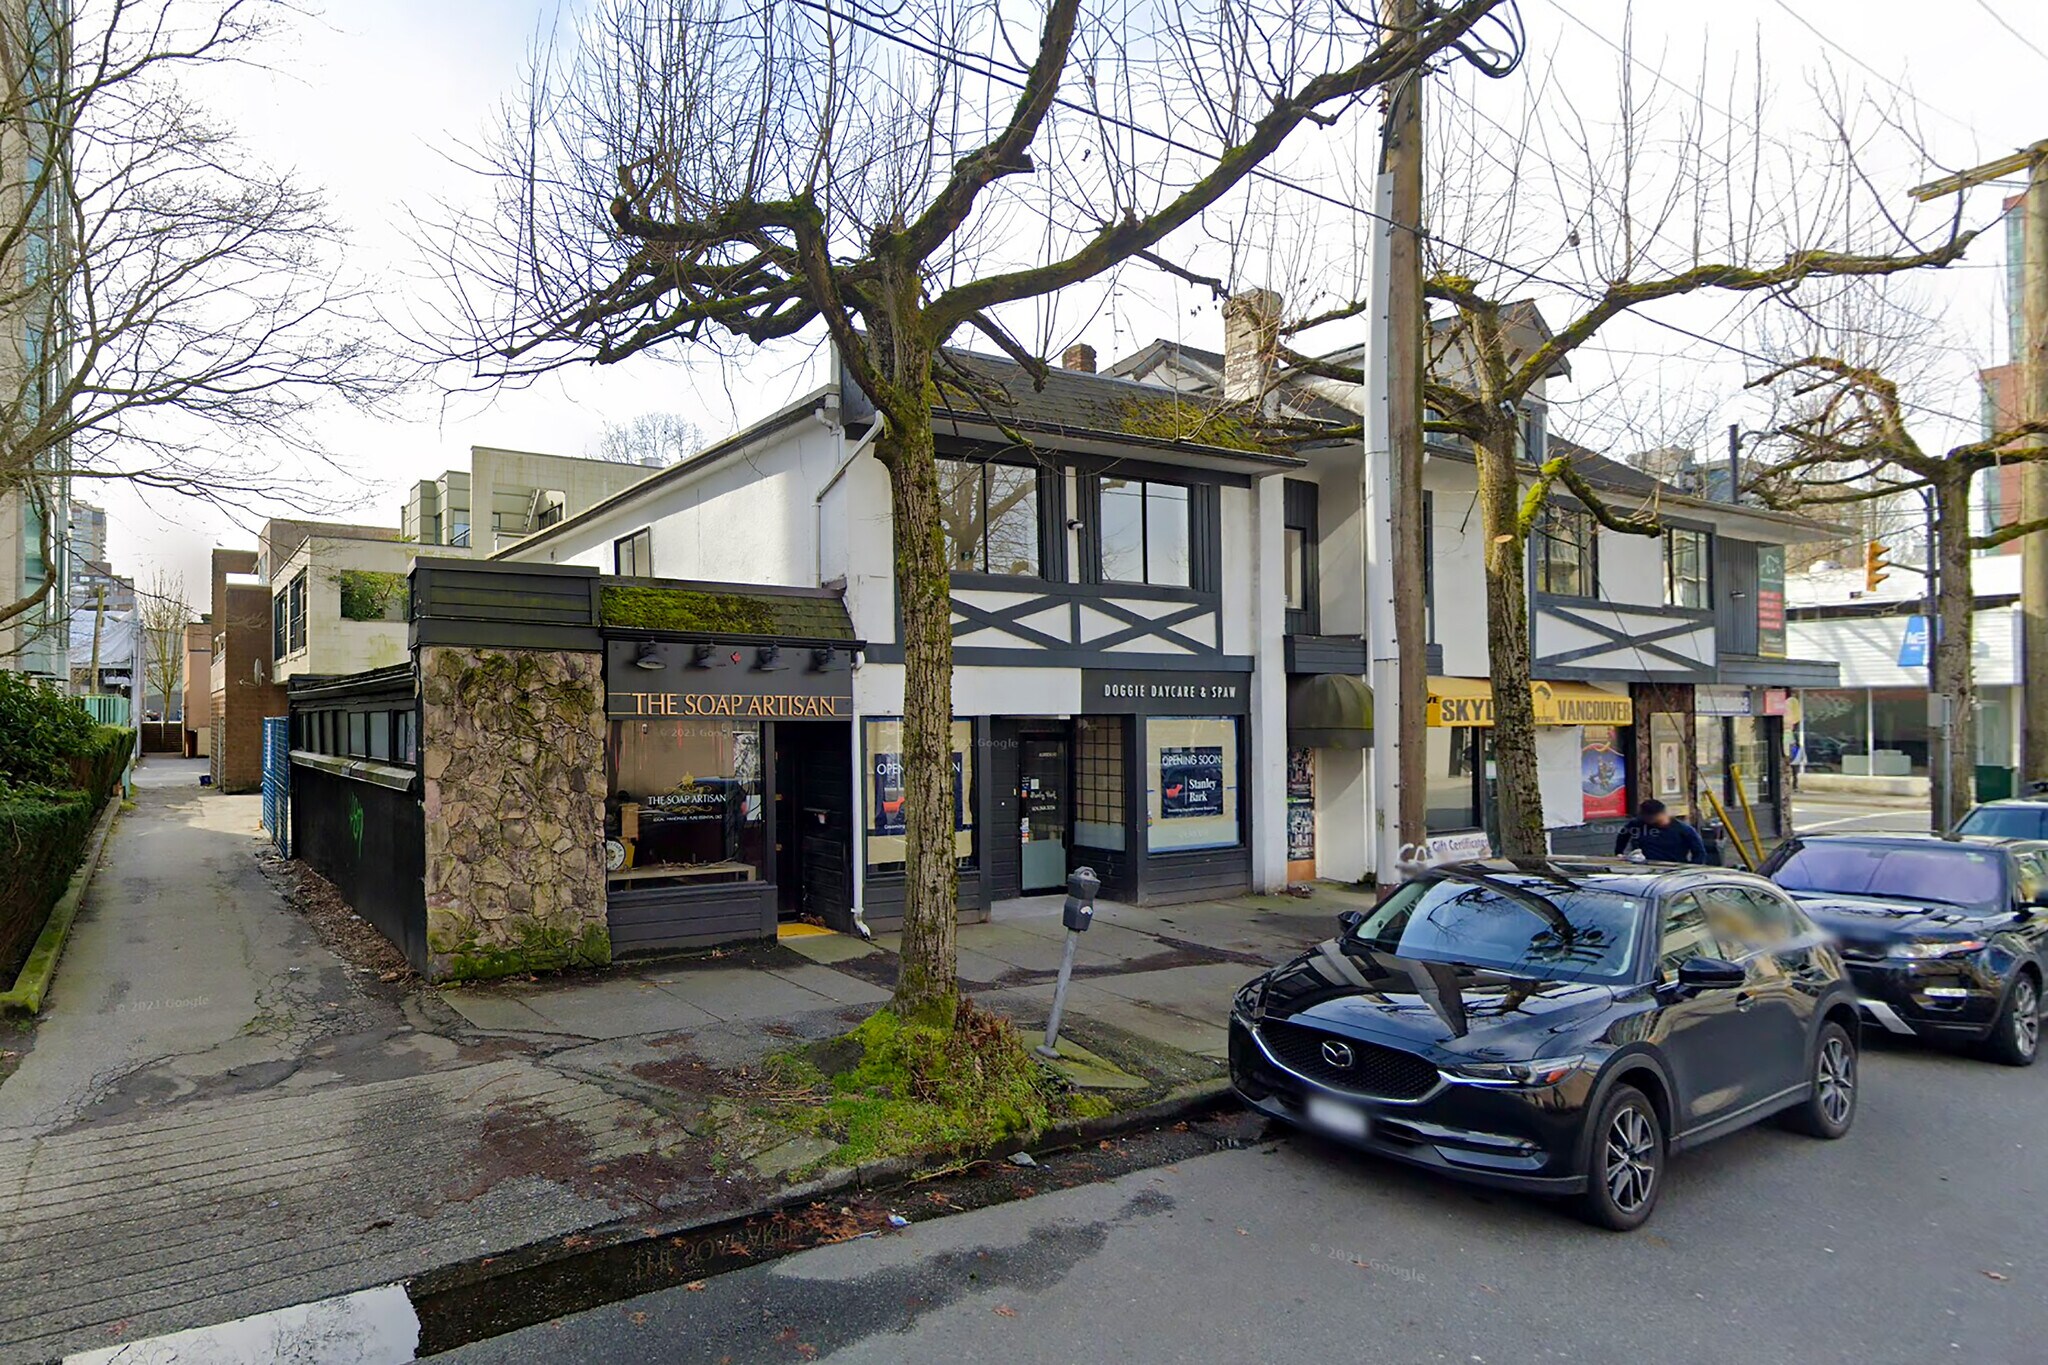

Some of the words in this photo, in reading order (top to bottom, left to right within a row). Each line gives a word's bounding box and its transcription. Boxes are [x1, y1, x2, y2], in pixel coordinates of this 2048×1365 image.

[1104, 684, 1145, 697] DOGGIE
[1151, 685, 1195, 698] DAYCARE
[1200, 686, 1206, 697] &
[1212, 686, 1236, 698] SPAW
[631, 692, 678, 715] THE
[684, 694, 745, 716] SOAP
[749, 696, 835, 717] ARTISAN
[1558, 700, 1632, 721] VANCOUVER
[1162, 755, 1197, 766] OPENING
[1198, 755, 1222, 765] SOON
[1189, 778, 1216, 790] Stanley
[648, 796, 667, 805] THE
[667, 795, 691, 805] SOAP
[691, 794, 726, 803] ARTISAN
[1189, 791, 1207, 802] Bark
[1432, 840, 1448, 852] Gift
